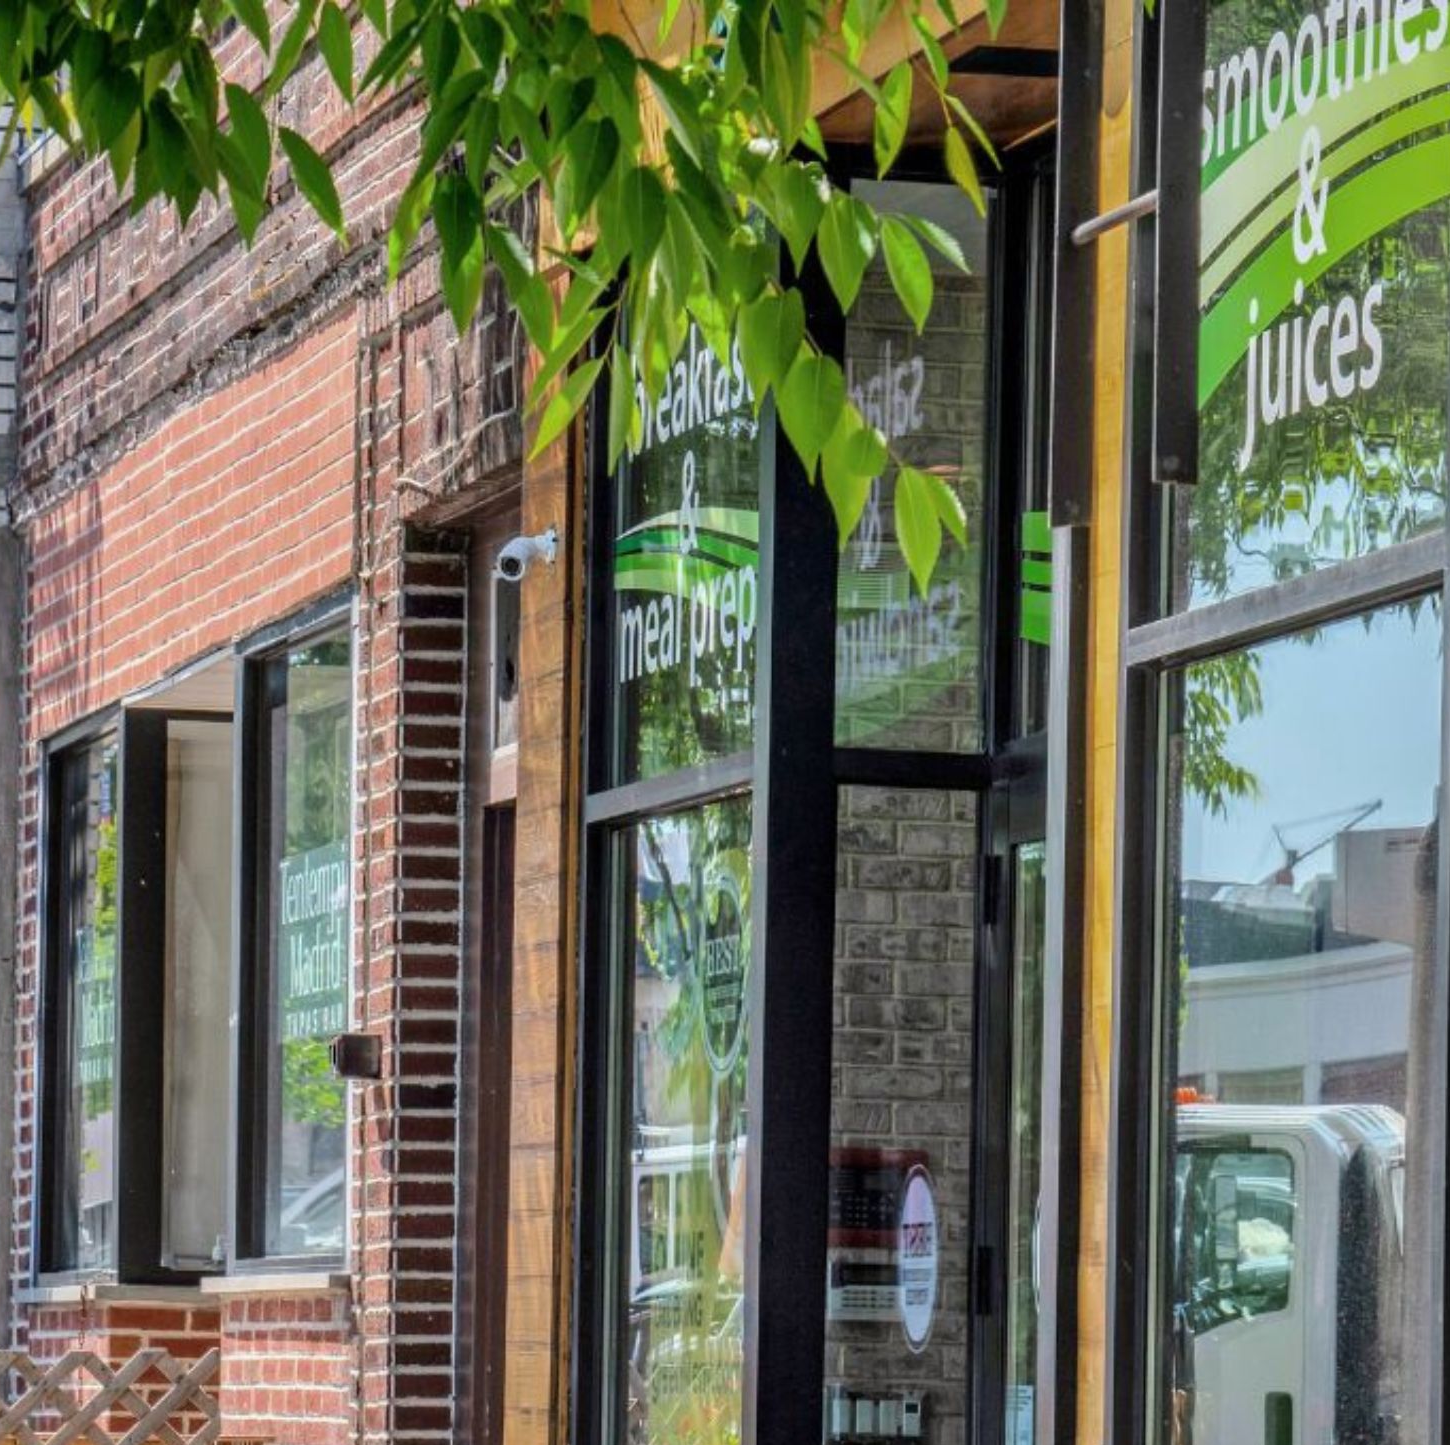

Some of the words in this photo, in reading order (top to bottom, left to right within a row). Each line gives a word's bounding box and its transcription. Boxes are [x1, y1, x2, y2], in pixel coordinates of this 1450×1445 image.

[1292, 125, 1329, 264] &
[1235, 277, 1384, 474] juices
[679, 450, 699, 556] &
[620, 556, 683, 683] meal
[690, 564, 757, 688] prep
[706, 934, 741, 977] BEST
